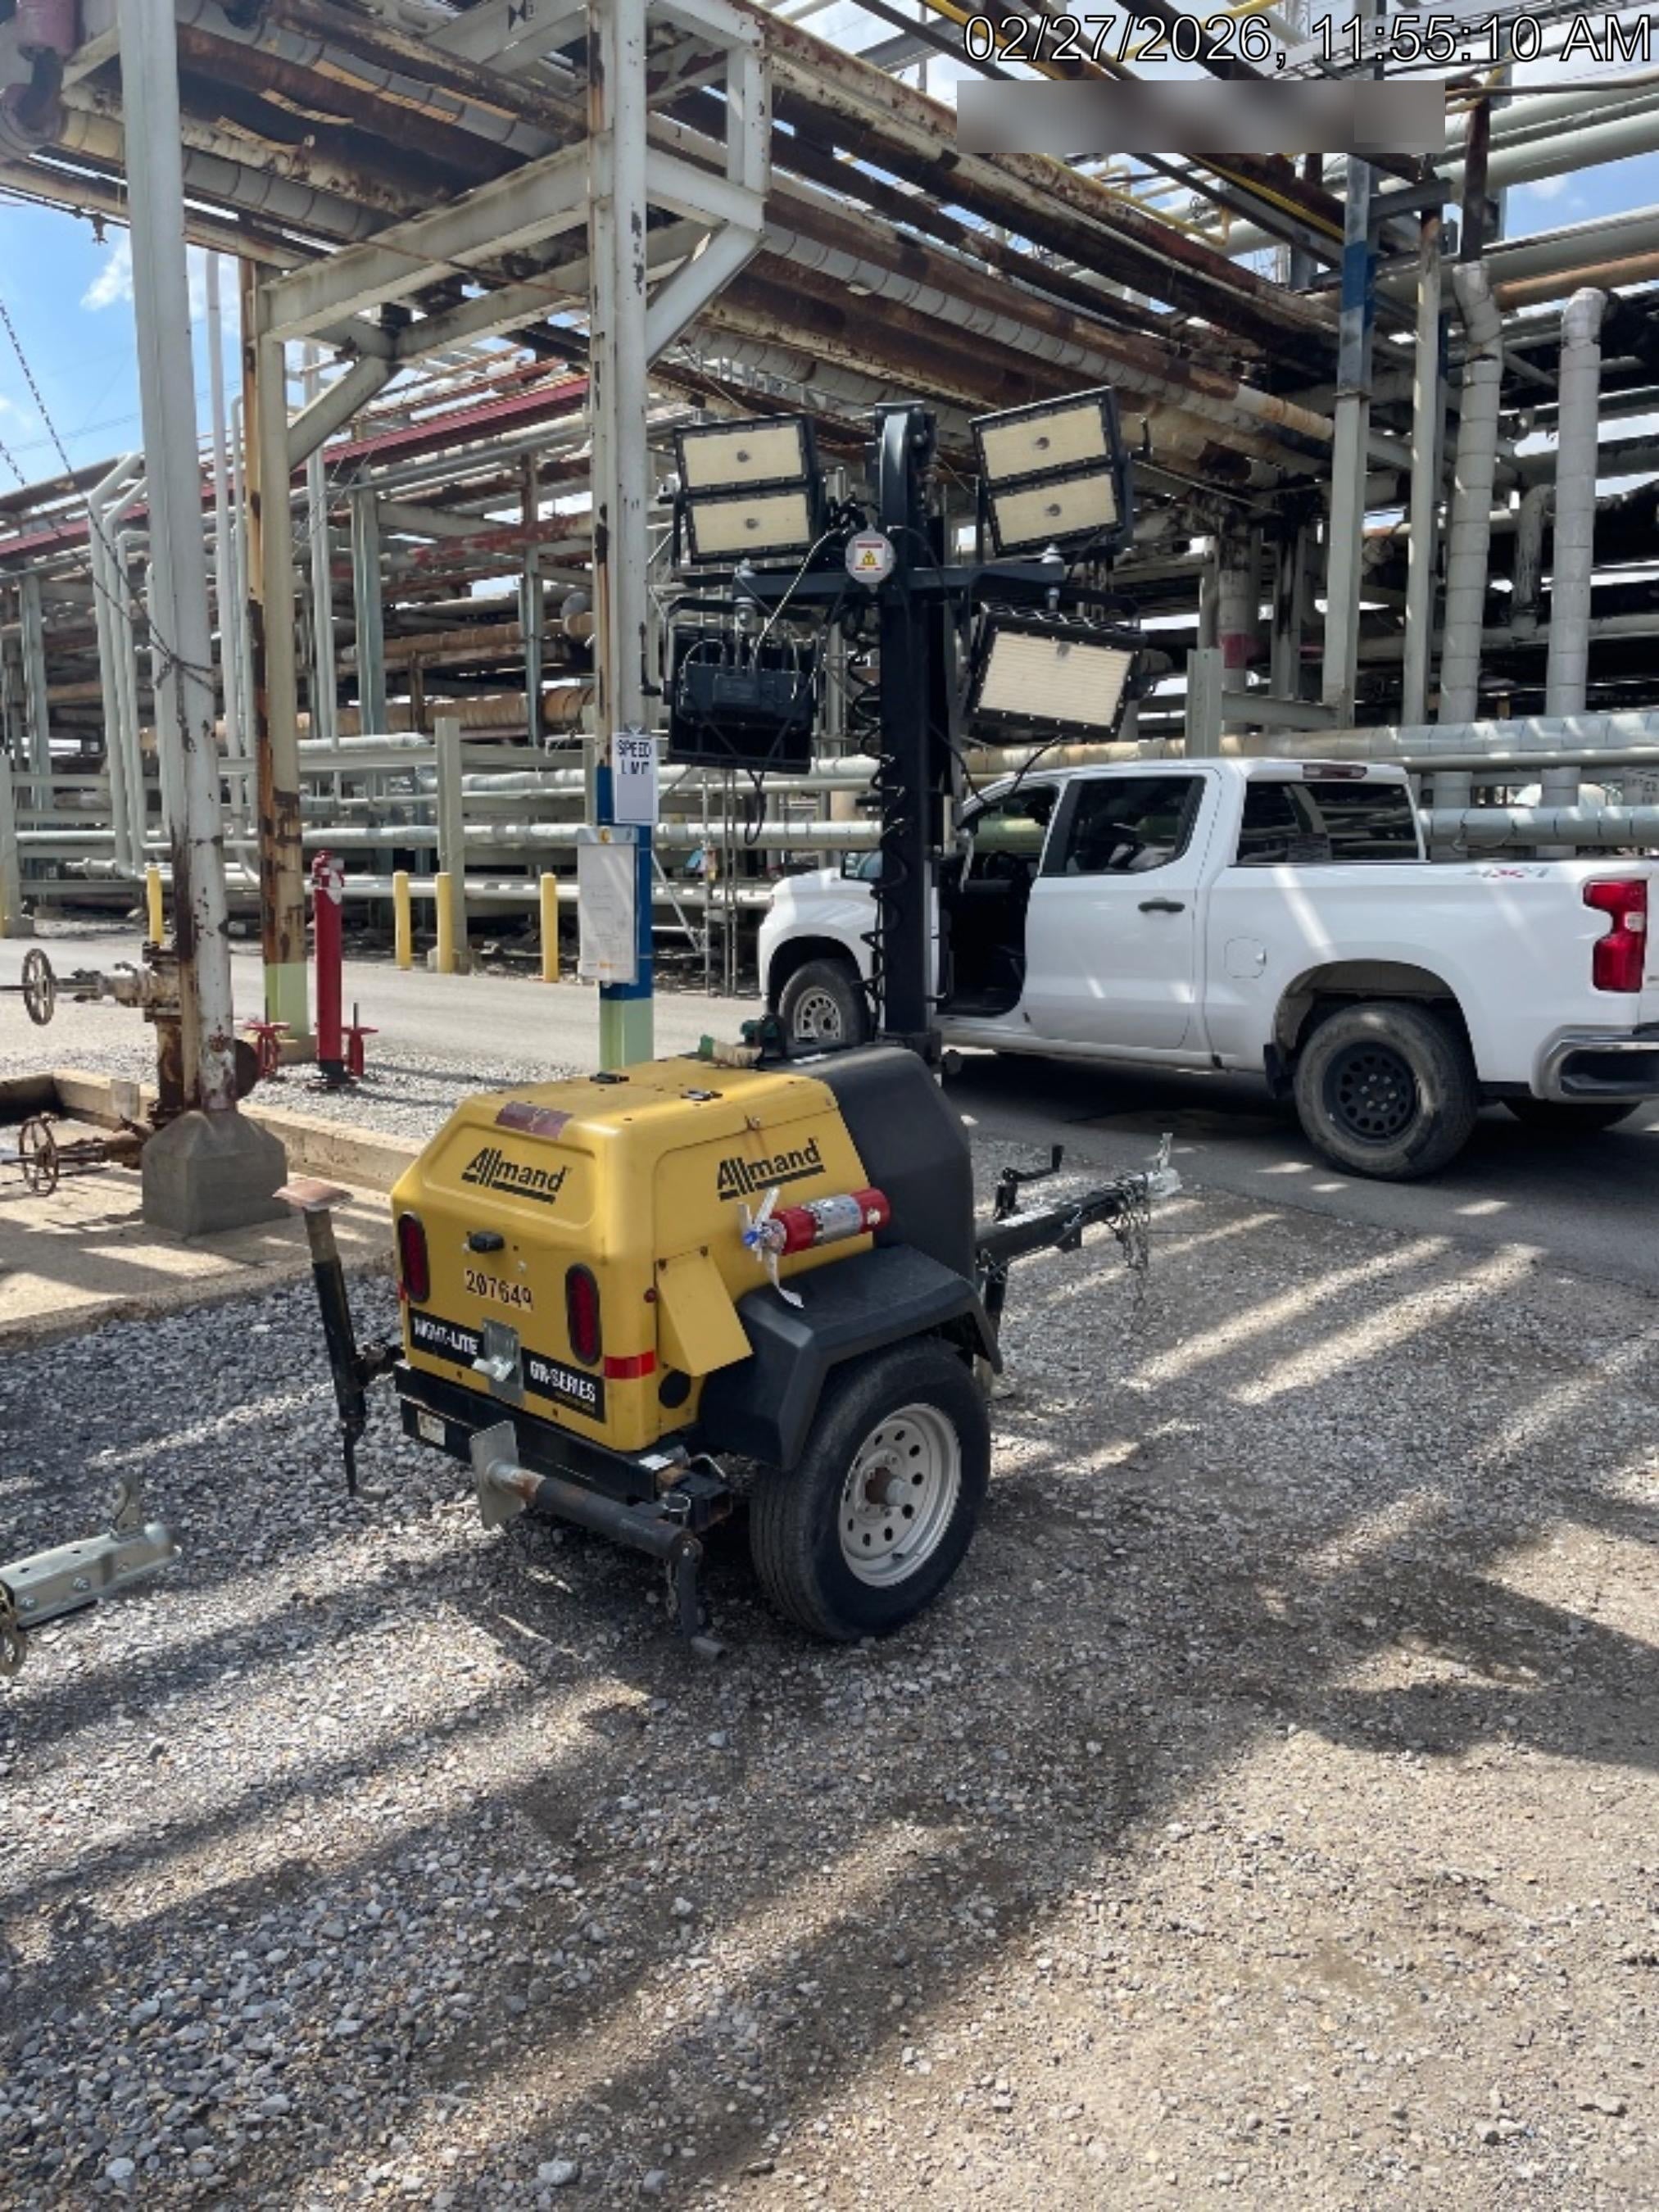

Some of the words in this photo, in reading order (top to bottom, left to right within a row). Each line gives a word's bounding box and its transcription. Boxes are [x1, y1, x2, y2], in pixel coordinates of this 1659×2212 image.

[618, 739, 652, 758] SPEED
[465, 1147, 567, 1193] Allmand
[716, 1136, 822, 1195] Allmand
[465, 1269, 534, 1311] 207649
